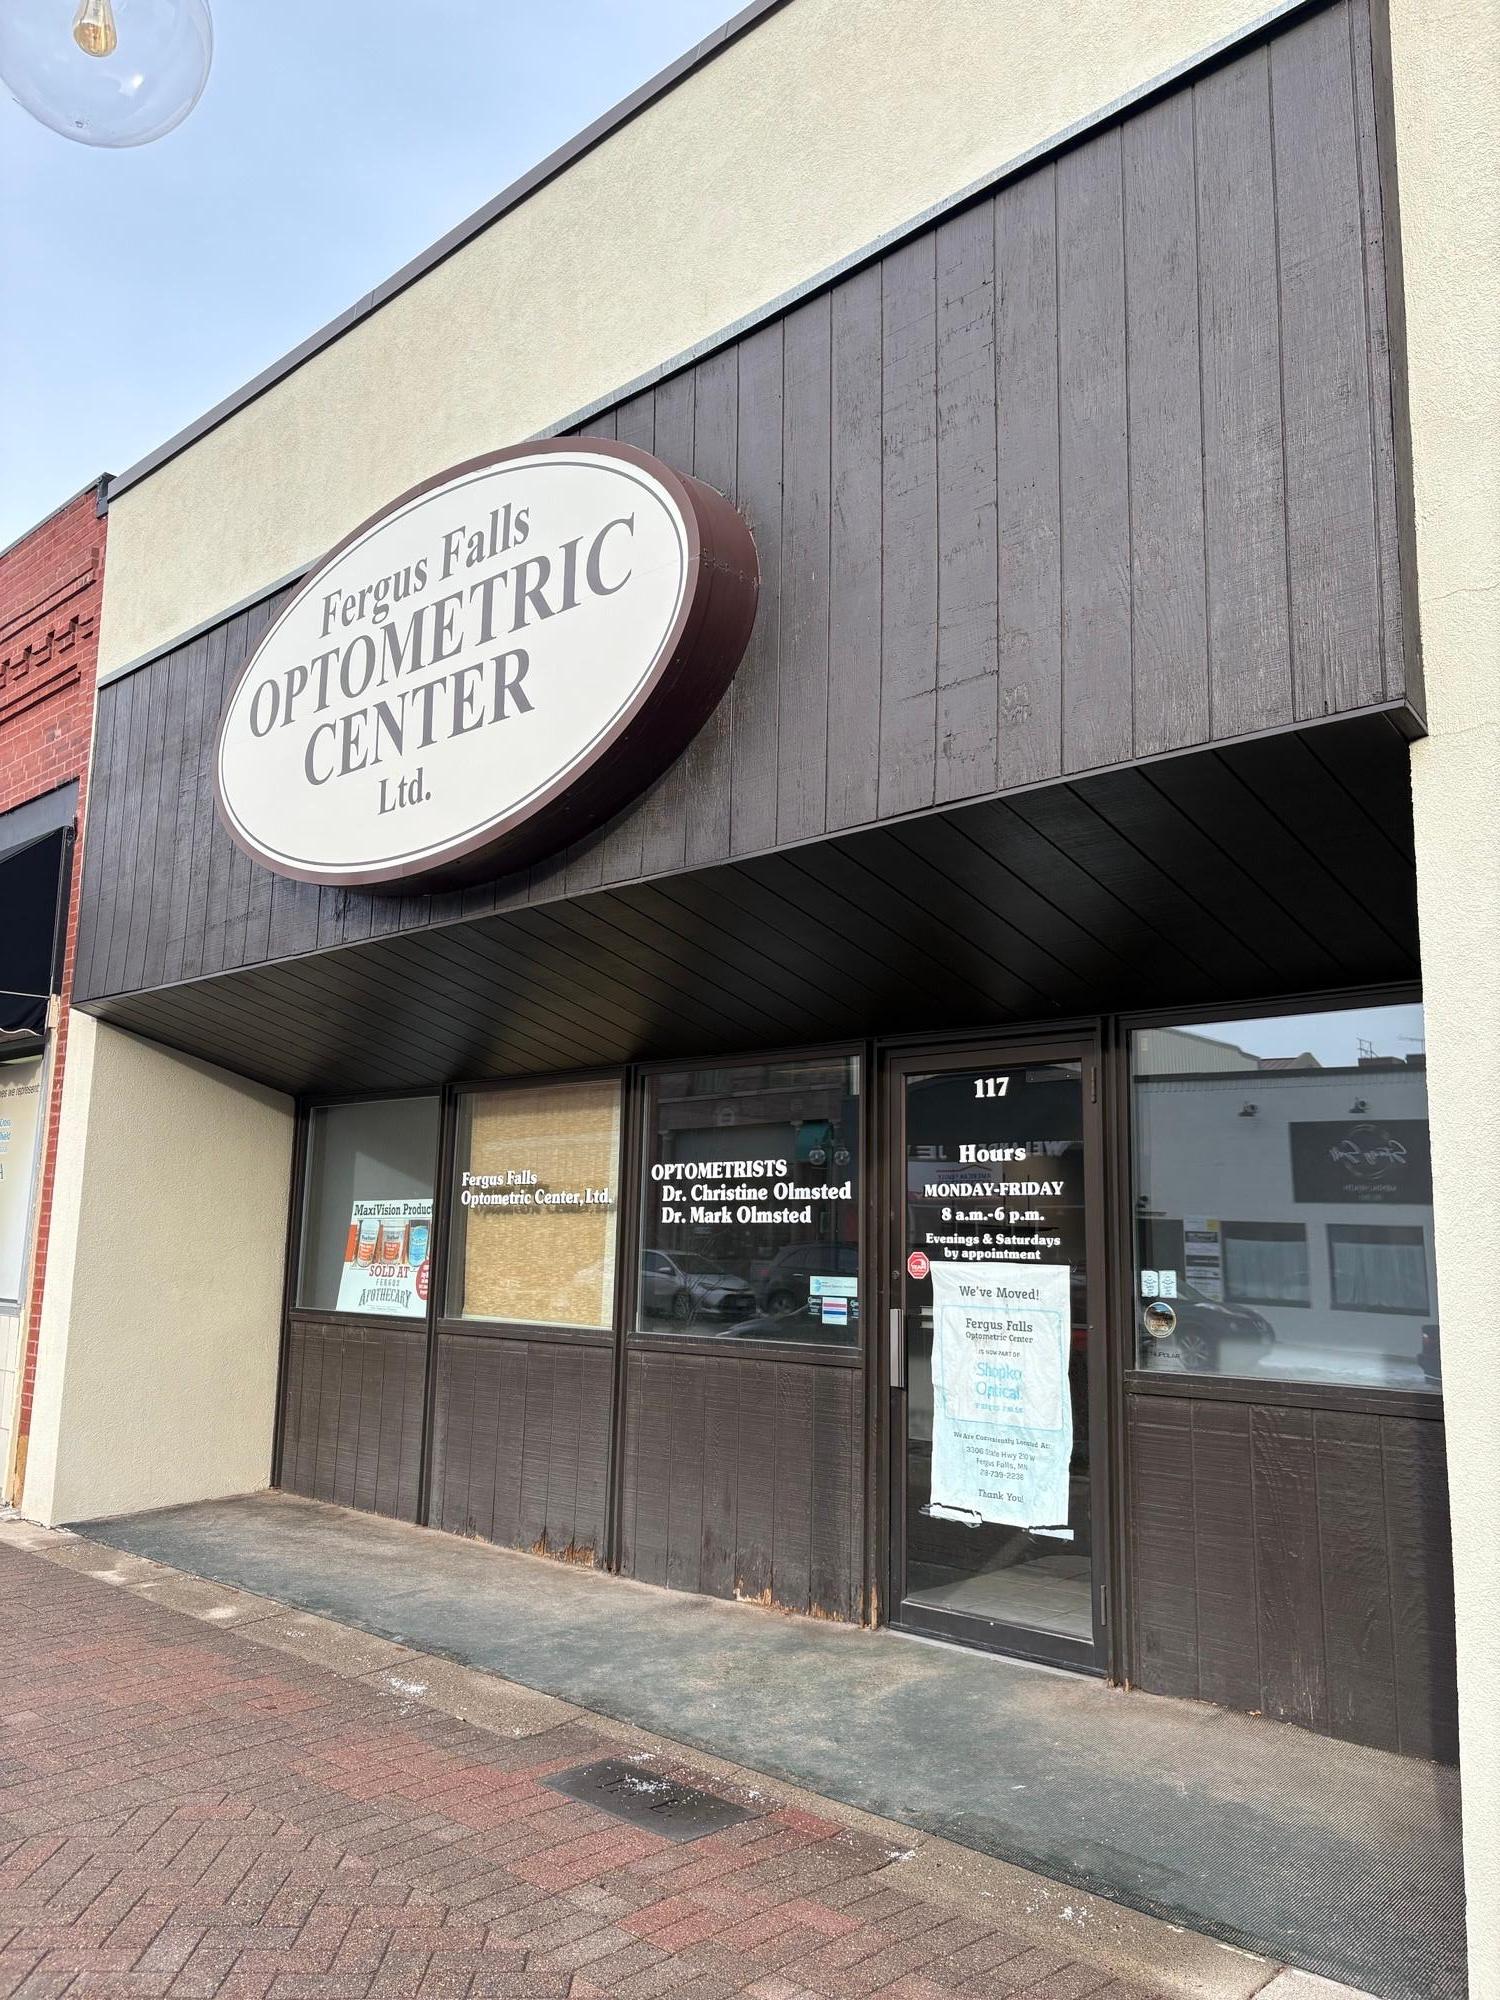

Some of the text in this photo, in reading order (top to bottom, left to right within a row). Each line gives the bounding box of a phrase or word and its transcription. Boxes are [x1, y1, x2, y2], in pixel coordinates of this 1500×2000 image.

[318, 502, 531, 639] Fergus Falls
[249, 512, 636, 738] OPTOMETRIC
[303, 648, 536, 786] CENTER
[377, 767, 432, 816] Ltd.
[973, 1076, 1010, 1099] 117
[958, 1144, 1027, 1163] Hours
[651, 1159, 787, 1181] OPTOMETRISTS
[461, 1170, 538, 1189] Fergus Falls
[460, 1187, 613, 1208] Optometric Center, Ltd.
[662, 1181, 852, 1202] Dr. Christine Olmsted
[924, 1181, 1064, 1198] MONDAY-FRIDAY
[354, 1204, 402, 1216] MaxiVision
[661, 1205, 812, 1224] Dr. Mark Olmsted
[941, 1207, 952, 1221] 8
[1009, 1209, 1045, 1224] p.m.
[925, 1233, 1061, 1247] Evenings & Saturdays
[944, 1247, 1041, 1260] by appointment
[369, 1264, 411, 1278] SOLD AT
[376, 1278, 400, 1286] FERGUS
[359, 1288, 412, 1308] APOTHECARY
[959, 1286, 1040, 1301] We've Moved!
[965, 1317, 1034, 1333] Fergus Falls
[965, 1331, 1034, 1344] Optometric Center
[976, 1361, 1022, 1380] Shopko
[963, 1432, 975, 1440] Are
[1001, 1451, 1017, 1460] Hwy
[978, 1488, 1024, 1503] Thank You!
